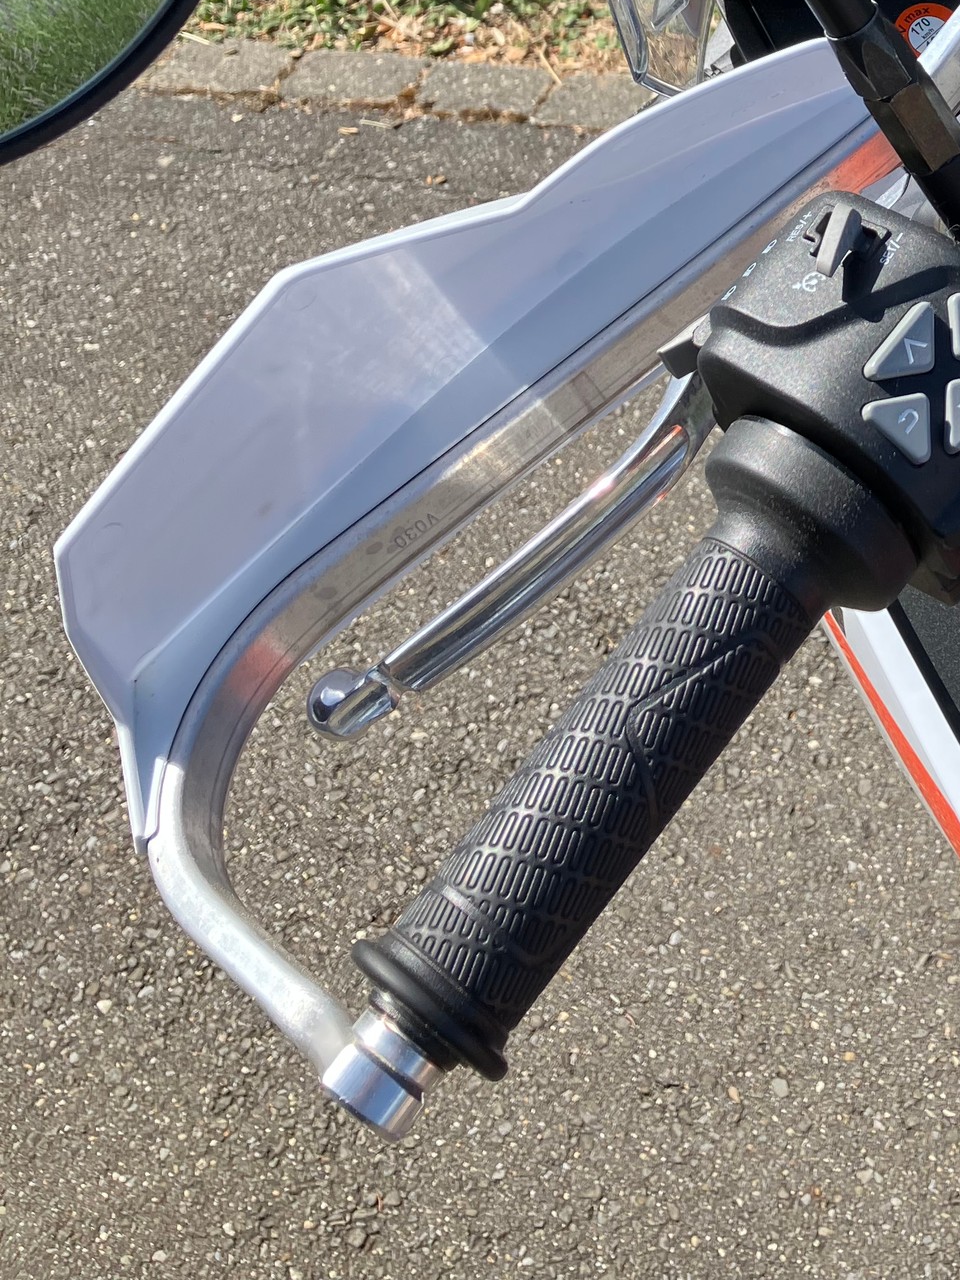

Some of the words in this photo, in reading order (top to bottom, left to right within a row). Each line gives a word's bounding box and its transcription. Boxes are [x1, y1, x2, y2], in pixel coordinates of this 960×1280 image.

[904, 7, 931, 24] max
[911, 17, 931, 36] 170
[921, 27, 935, 40] km/h
